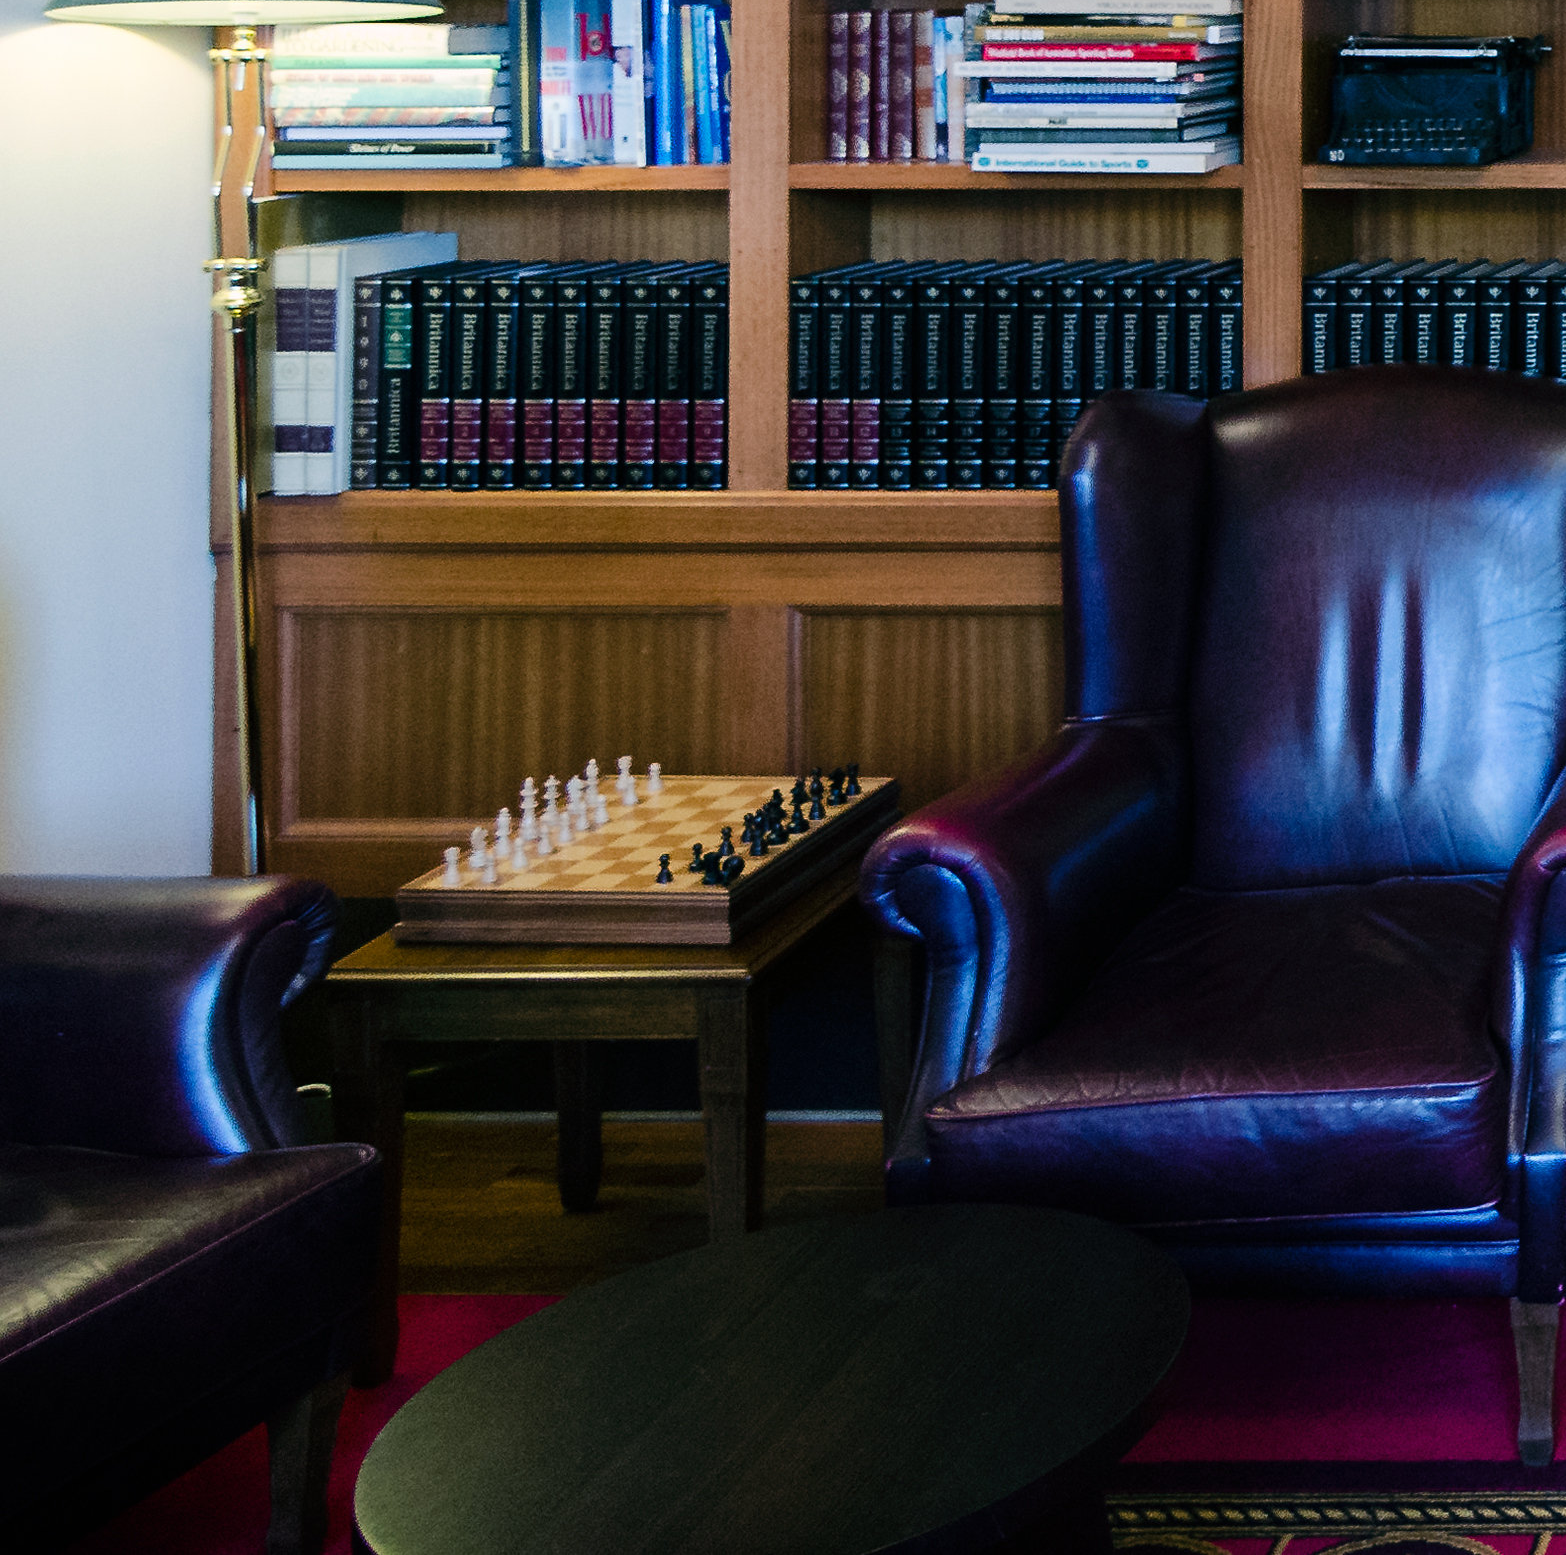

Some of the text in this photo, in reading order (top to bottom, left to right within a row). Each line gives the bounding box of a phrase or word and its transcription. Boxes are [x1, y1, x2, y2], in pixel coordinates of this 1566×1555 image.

[995, 158, 1133, 170] International Guide to Sports
[462, 313, 478, 390] Britannica
[495, 313, 512, 390] Britannica
[531, 313, 546, 390] Britannica
[598, 313, 613, 390] Britannica
[633, 313, 649, 390] Britannica
[667, 313, 682, 390] Britannica
[798, 313, 813, 391] Britannica
[829, 313, 844, 391] Britannica
[892, 313, 907, 391] Britannica
[927, 313, 942, 391] Britannica
[962, 313, 977, 391] Britannica
[1032, 313, 1047, 391] Britannica
[1062, 313, 1077, 391] Britannica
[1094, 313, 1109, 391] Britannica
[1155, 313, 1170, 391] Britannica
[1188, 313, 1203, 391] Britannica
[1220, 313, 1235, 391] Britannica
[387, 377, 402, 454] Britannica
